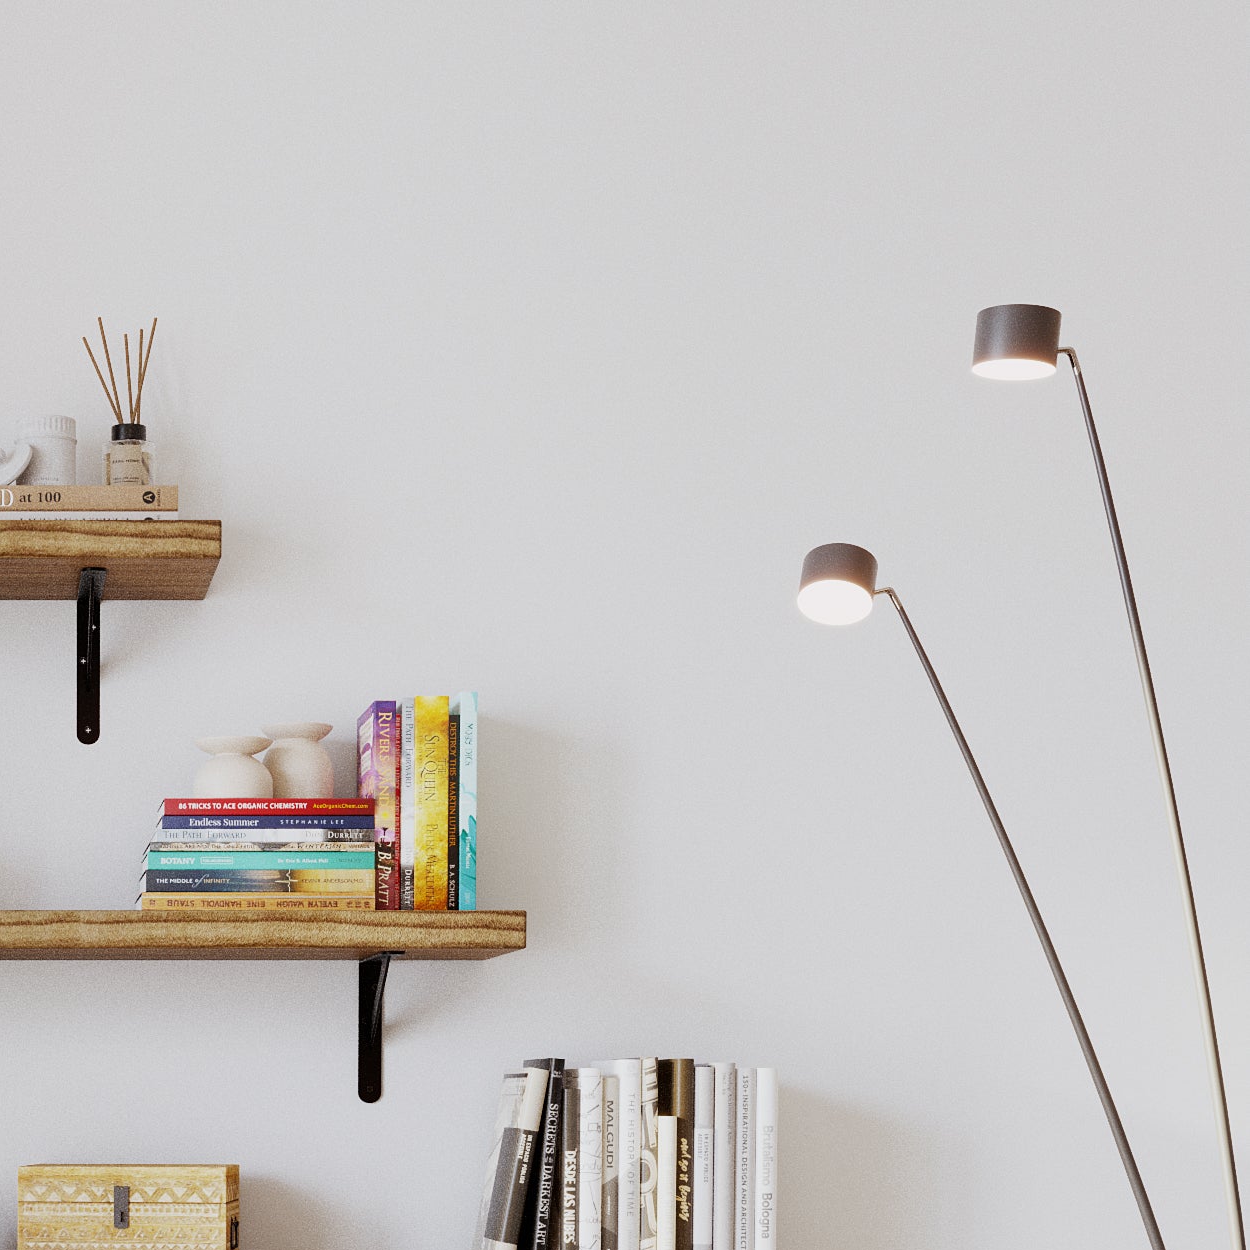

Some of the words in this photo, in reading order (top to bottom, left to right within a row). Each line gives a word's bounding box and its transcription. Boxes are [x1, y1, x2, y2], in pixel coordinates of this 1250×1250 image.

[19, 493, 32, 503] at
[38, 492, 62, 503] 100
[424, 734, 439, 758] SUN
[449, 722, 457, 758] DESTROY
[421, 760, 438, 802] QUEEN
[449, 760, 457, 777] THIS
[188, 802, 212, 810] TRICKS
[212, 802, 222, 810] TO
[223, 802, 236, 810] ACE
[237, 802, 268, 810] ORGANIC
[269, 802, 308, 810] CHEMISTRY
[449, 781, 457, 811] MARTIN
[189, 818, 222, 827] Endless
[223, 818, 260, 827] Summer
[449, 813, 457, 848] LUTHER
[740, 1074, 749, 1094] 150+
[627, 1093, 636, 1113] THE
[546, 1103, 559, 1154] SECRETS
[606, 1100, 614, 1169] MALGUDI
[741, 1095, 749, 1155] INSPIRATIONAL
[627, 1125, 636, 1165] HISTORY
[627, 1171, 636, 1185] OF
[539, 1165, 553, 1220] DARKEST
[627, 1190, 636, 1217] TIME
[740, 1187, 748, 1205] AND
[536, 1222, 548, 1246] ART
